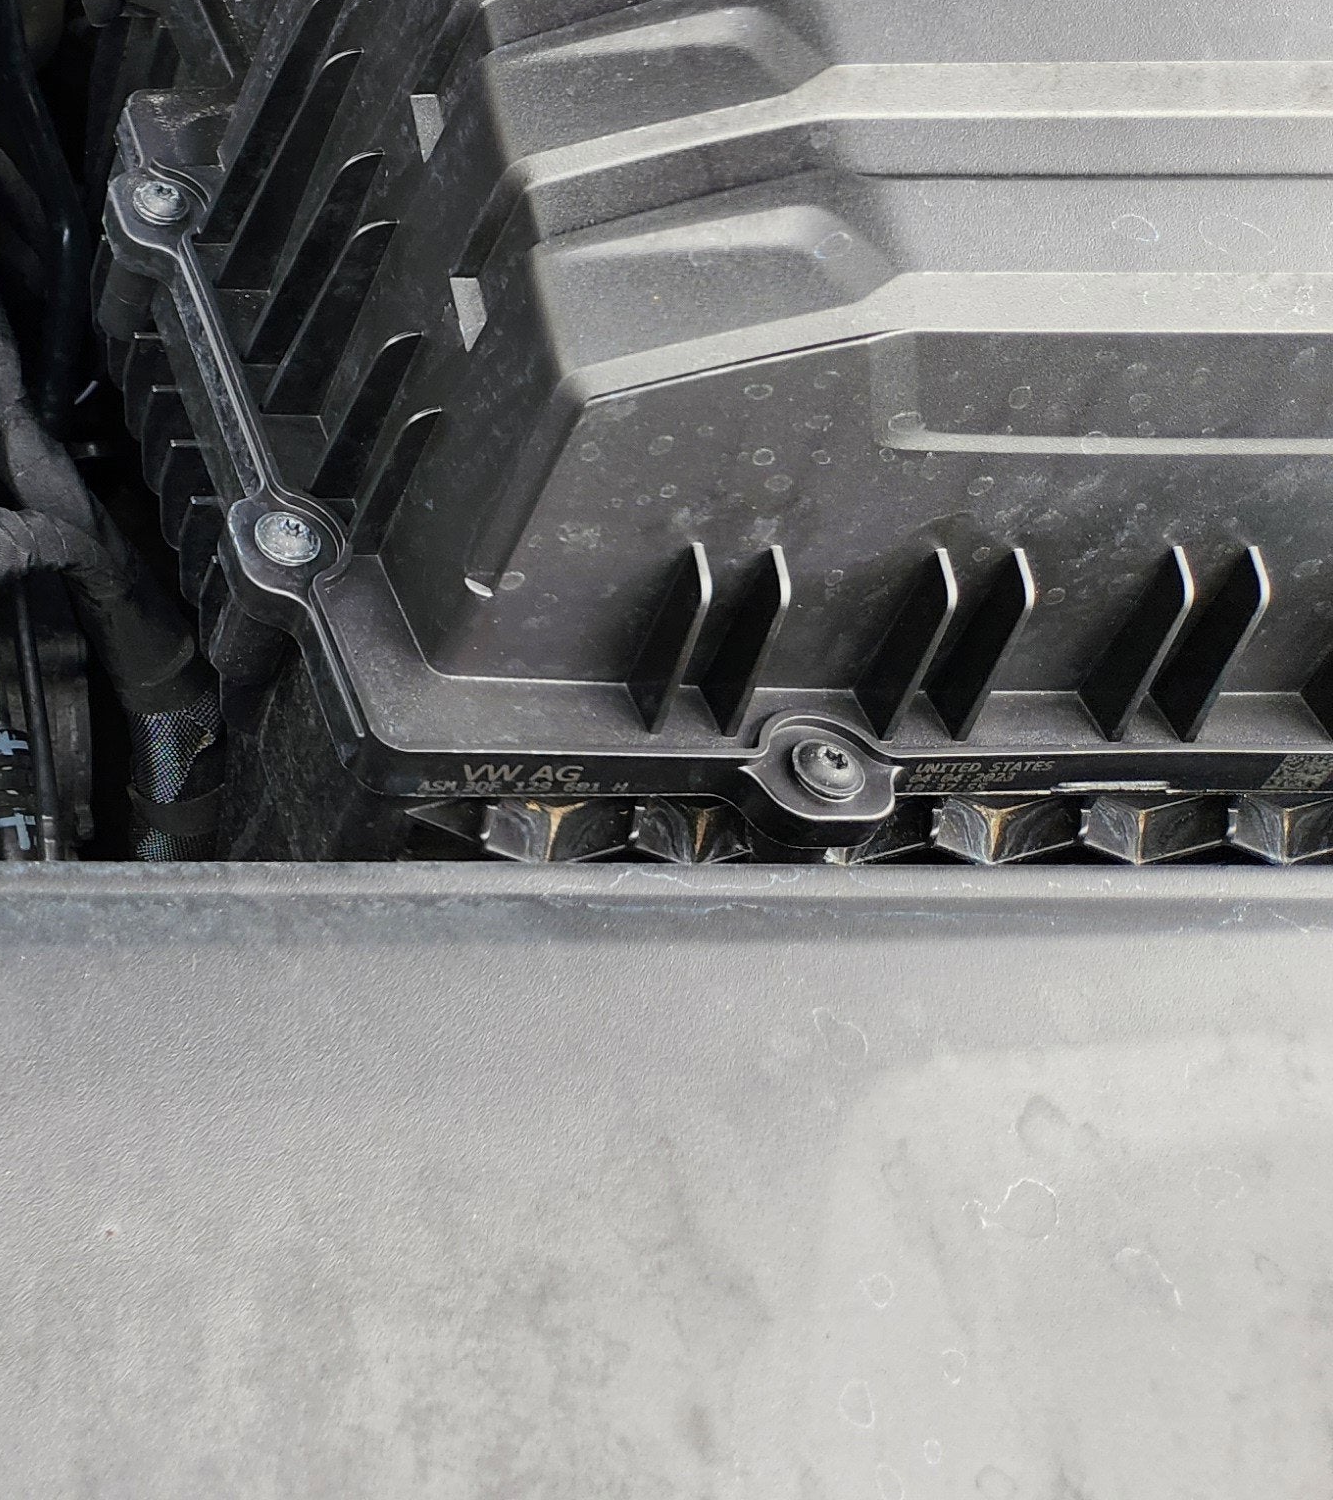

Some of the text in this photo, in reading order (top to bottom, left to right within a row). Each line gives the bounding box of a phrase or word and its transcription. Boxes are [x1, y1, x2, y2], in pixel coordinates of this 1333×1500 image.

[463, 763, 585, 782] VW AG
[915, 760, 1056, 774] UNITED STATES
